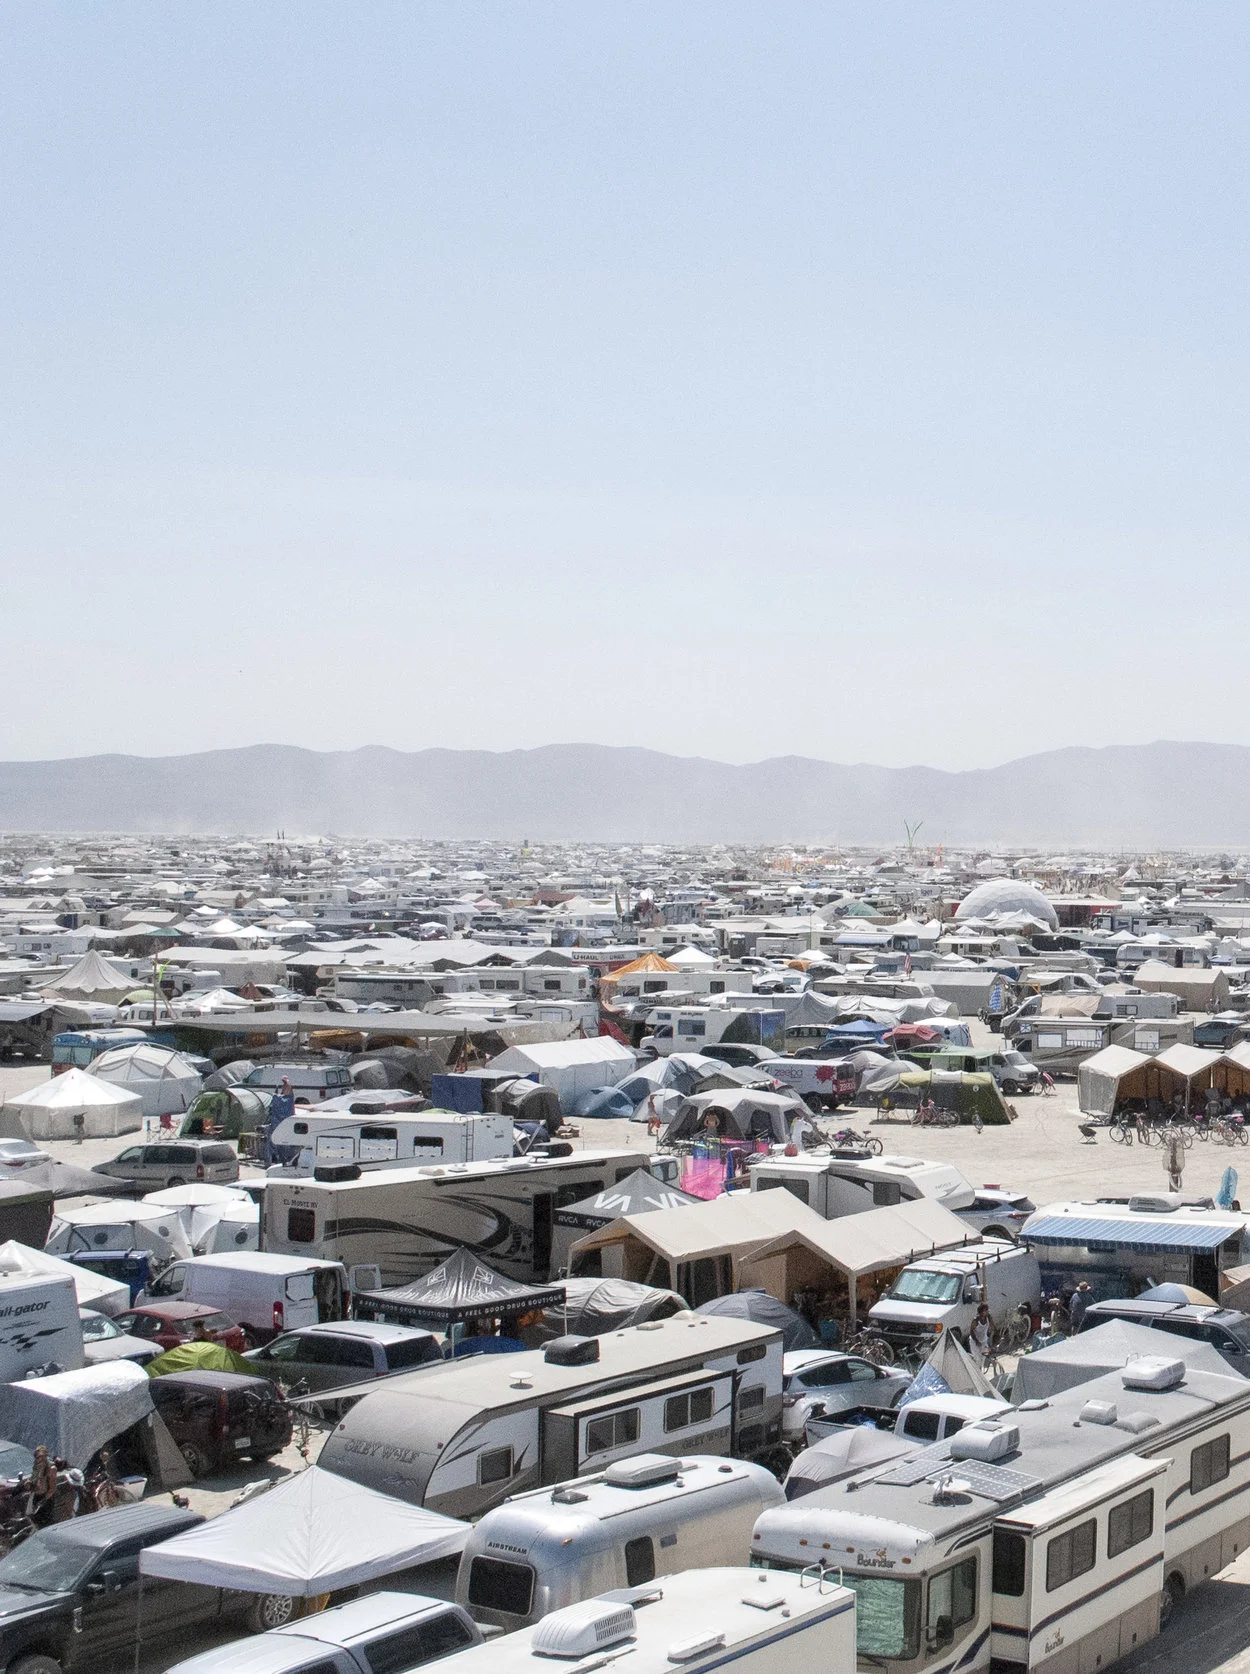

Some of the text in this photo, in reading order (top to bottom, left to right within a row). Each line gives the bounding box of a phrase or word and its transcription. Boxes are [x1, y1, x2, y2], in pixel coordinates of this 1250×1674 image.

[774, 1066, 803, 1077] zeeba
[558, 1215, 579, 1224] RVCA
[484, 1305, 505, 1315] GOOD
[506, 1301, 526, 1310] DRUG
[527, 1294, 563, 1306] BOUTIQUE
[418, 1310, 449, 1319] BOUTIQUE
[381, 1444, 420, 1464] WOLF
[487, 1541, 528, 1555] AIRSTREAM
[857, 1553, 896, 1569] Bounder
